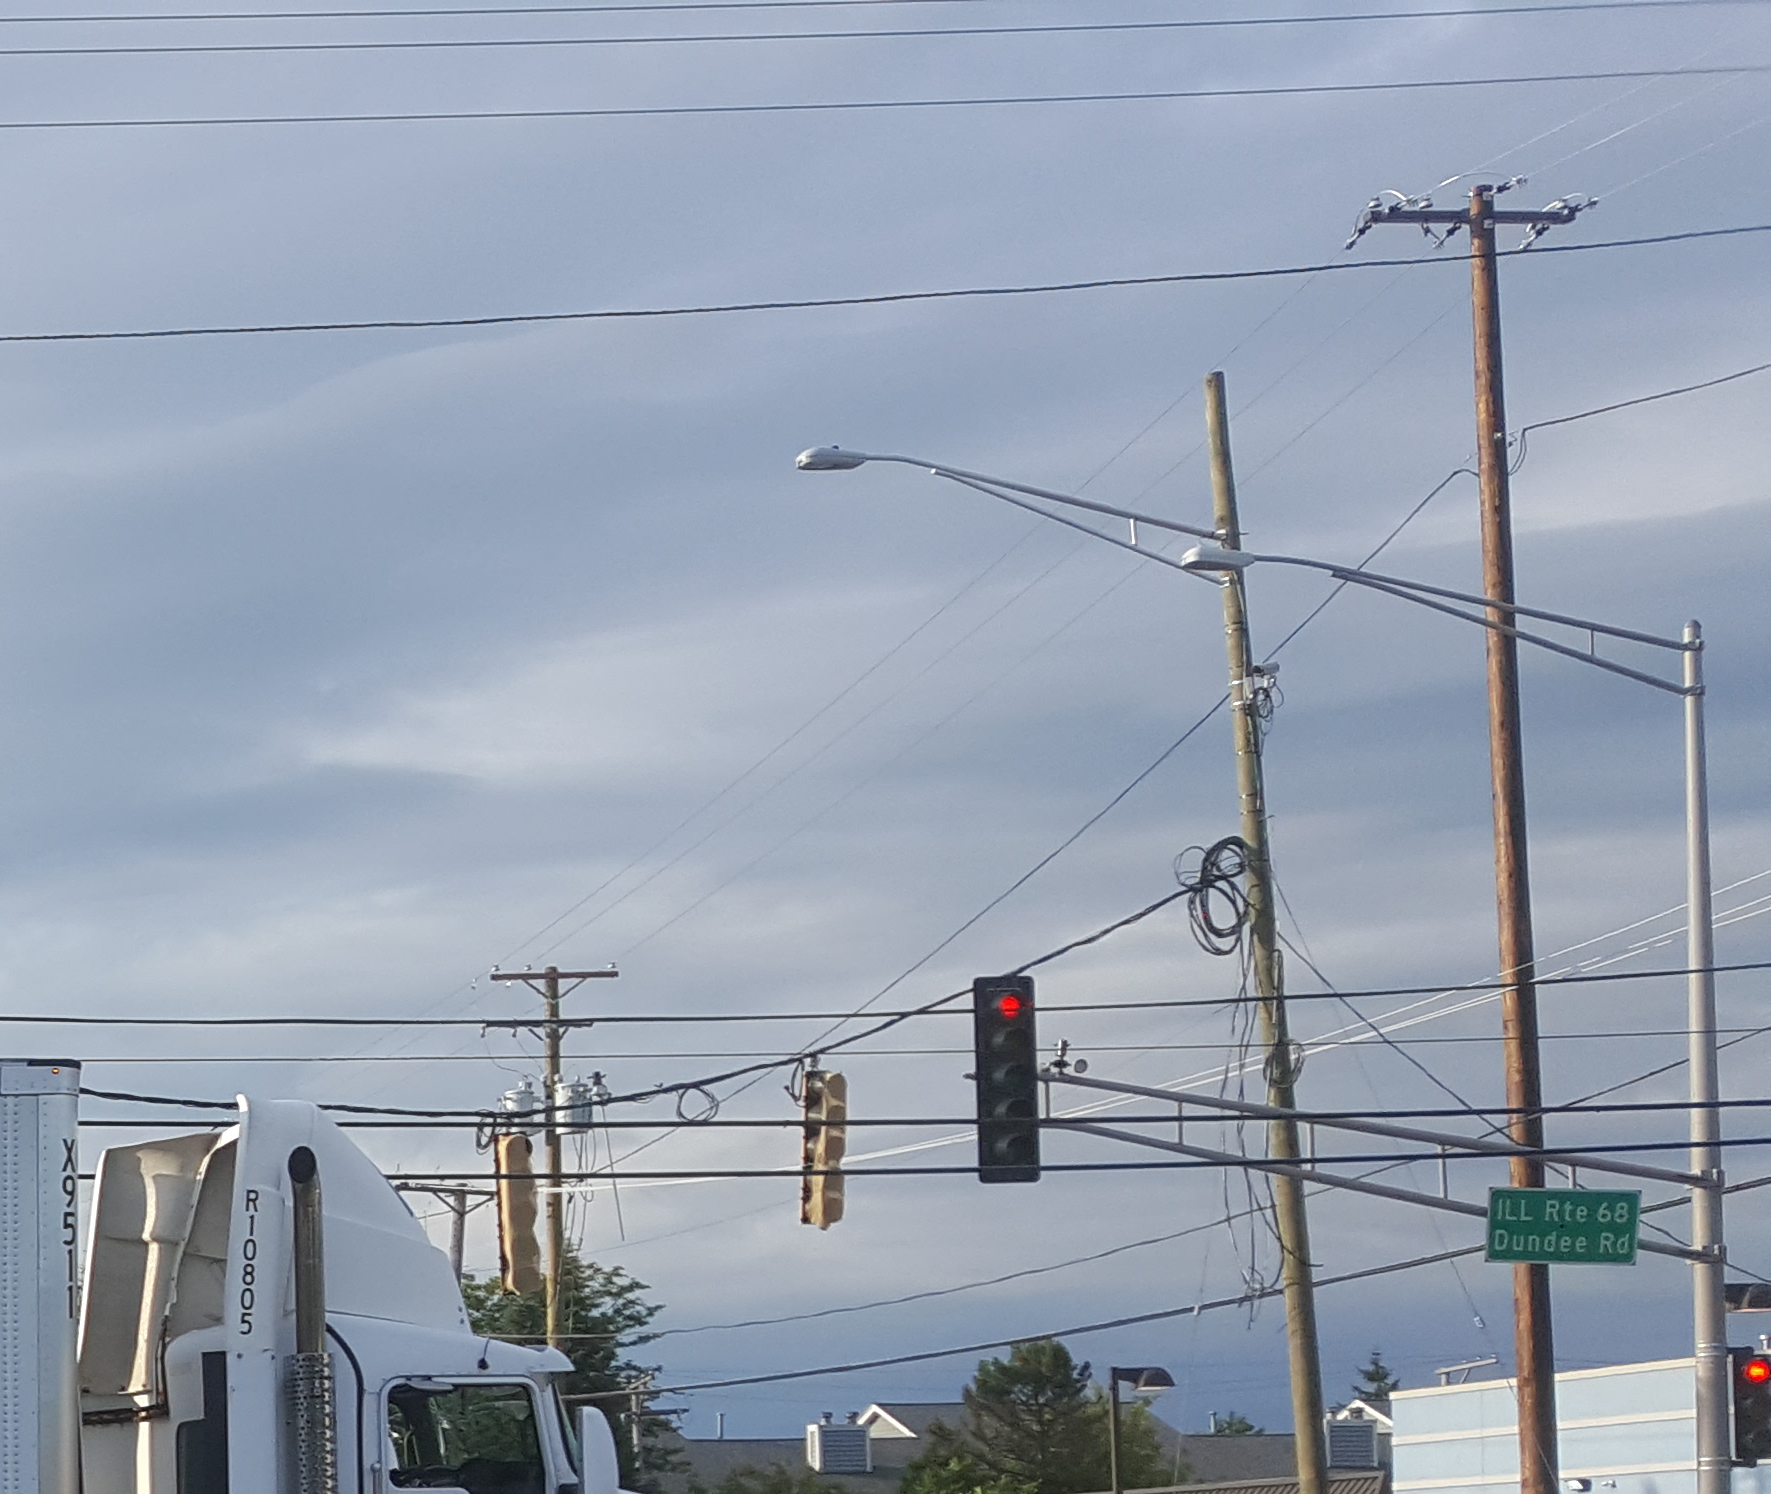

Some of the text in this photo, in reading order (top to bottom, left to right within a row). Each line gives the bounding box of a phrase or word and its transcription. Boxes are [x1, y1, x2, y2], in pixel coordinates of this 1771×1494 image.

[61, 1137, 77, 1319] X9511
[1494, 1229, 1630, 1255] Dundee Rd
[1497, 1198, 1629, 1223] ILL Rte 68
[239, 1189, 260, 1335] R10805
